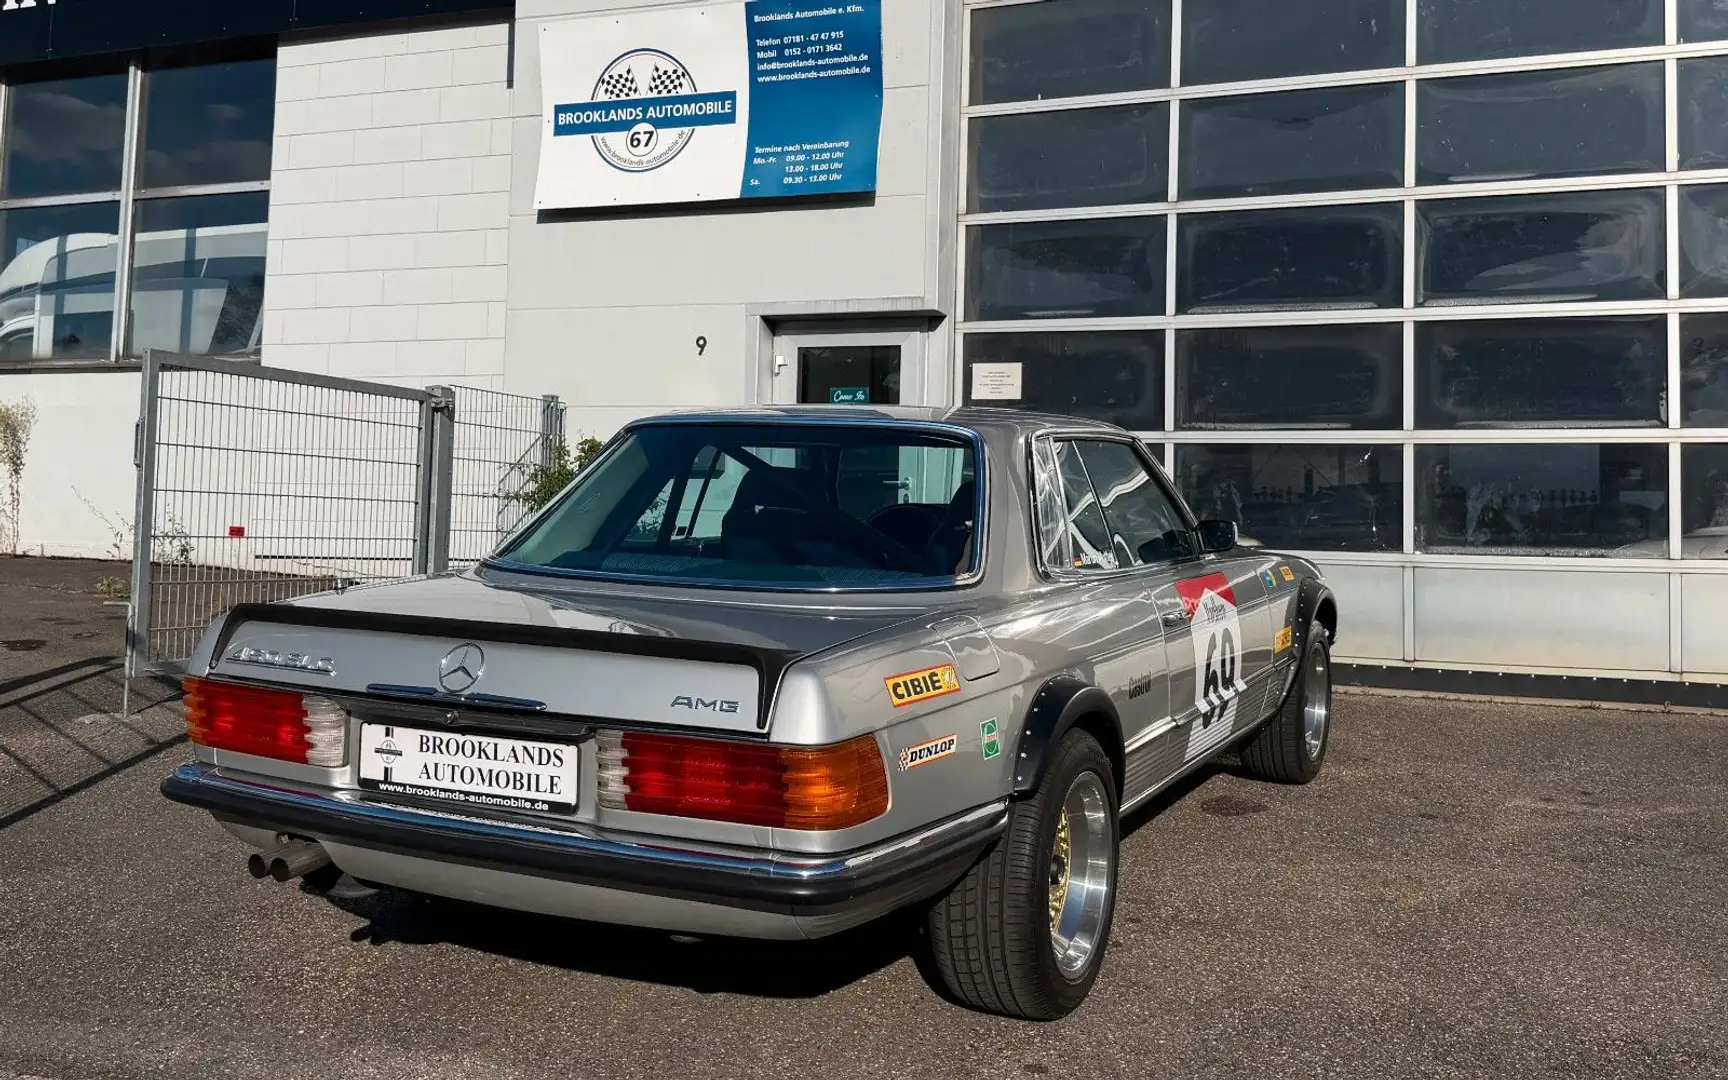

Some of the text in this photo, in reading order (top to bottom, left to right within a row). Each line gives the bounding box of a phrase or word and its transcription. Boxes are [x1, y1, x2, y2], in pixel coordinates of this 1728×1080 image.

[754, 12, 793, 22] Brooklands
[795, 7, 836, 18] Automobile
[846, 5, 864, 13] Kfm.
[756, 37, 780, 47] Telefon
[783, 35, 804, 45] 07181
[810, 33, 818, 41] 47
[820, 32, 829, 40] 47
[831, 31, 844, 39] 915
[757, 50, 776, 59] Mobil
[784, 48, 801, 56] 0152
[807, 45, 824, 54] 0171
[826, 43, 842, 52] 3642
[757, 53, 868, 71] info@brooklands-automobile.de
[757, 66, 870, 83] www.brooklands-automobile.de
[558, 100, 732, 125] BROOKLANDS AUTOMOBILE
[600, 129, 686, 167] www.brooklands-automobile.de
[629, 131, 654, 148] 67
[754, 141, 849, 154] Termine nach Vereinbarung
[753, 156, 776, 164] Mo.-Fr.
[786, 154, 805, 162] 09.00
[812, 152, 829, 160] 12.00
[785, 165, 804, 173] 13.00
[811, 163, 828, 171] 18.00
[783, 176, 802, 184] 09.30
[696, 335, 707, 356] 9
[834, 390, 853, 402] Come
[232, 647, 283, 666] 450
[670, 696, 740, 713] AMG
[419, 734, 564, 768] BROOKLANDS
[910, 739, 955, 763] DUNLOP
[418, 762, 562, 795] AUTOMOBILE
[379, 782, 549, 812] www.brooklands-automobile.de
